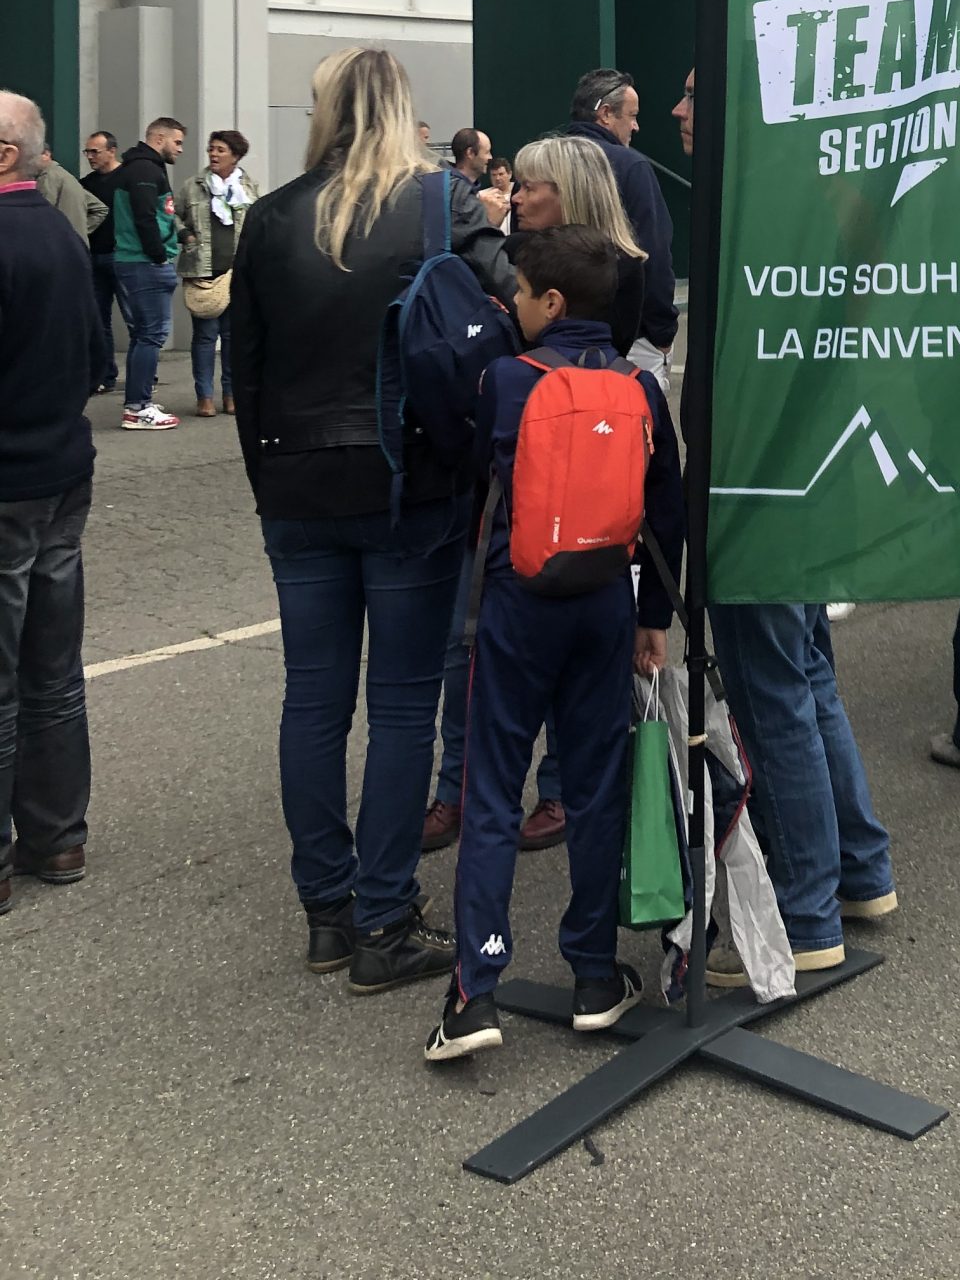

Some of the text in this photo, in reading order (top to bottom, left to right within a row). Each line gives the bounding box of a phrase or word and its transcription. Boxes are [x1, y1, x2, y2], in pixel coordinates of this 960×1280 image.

[819, 101, 958, 176] SECTION
[744, 265, 848, 297] VOUS
[757, 328, 805, 360] LA
